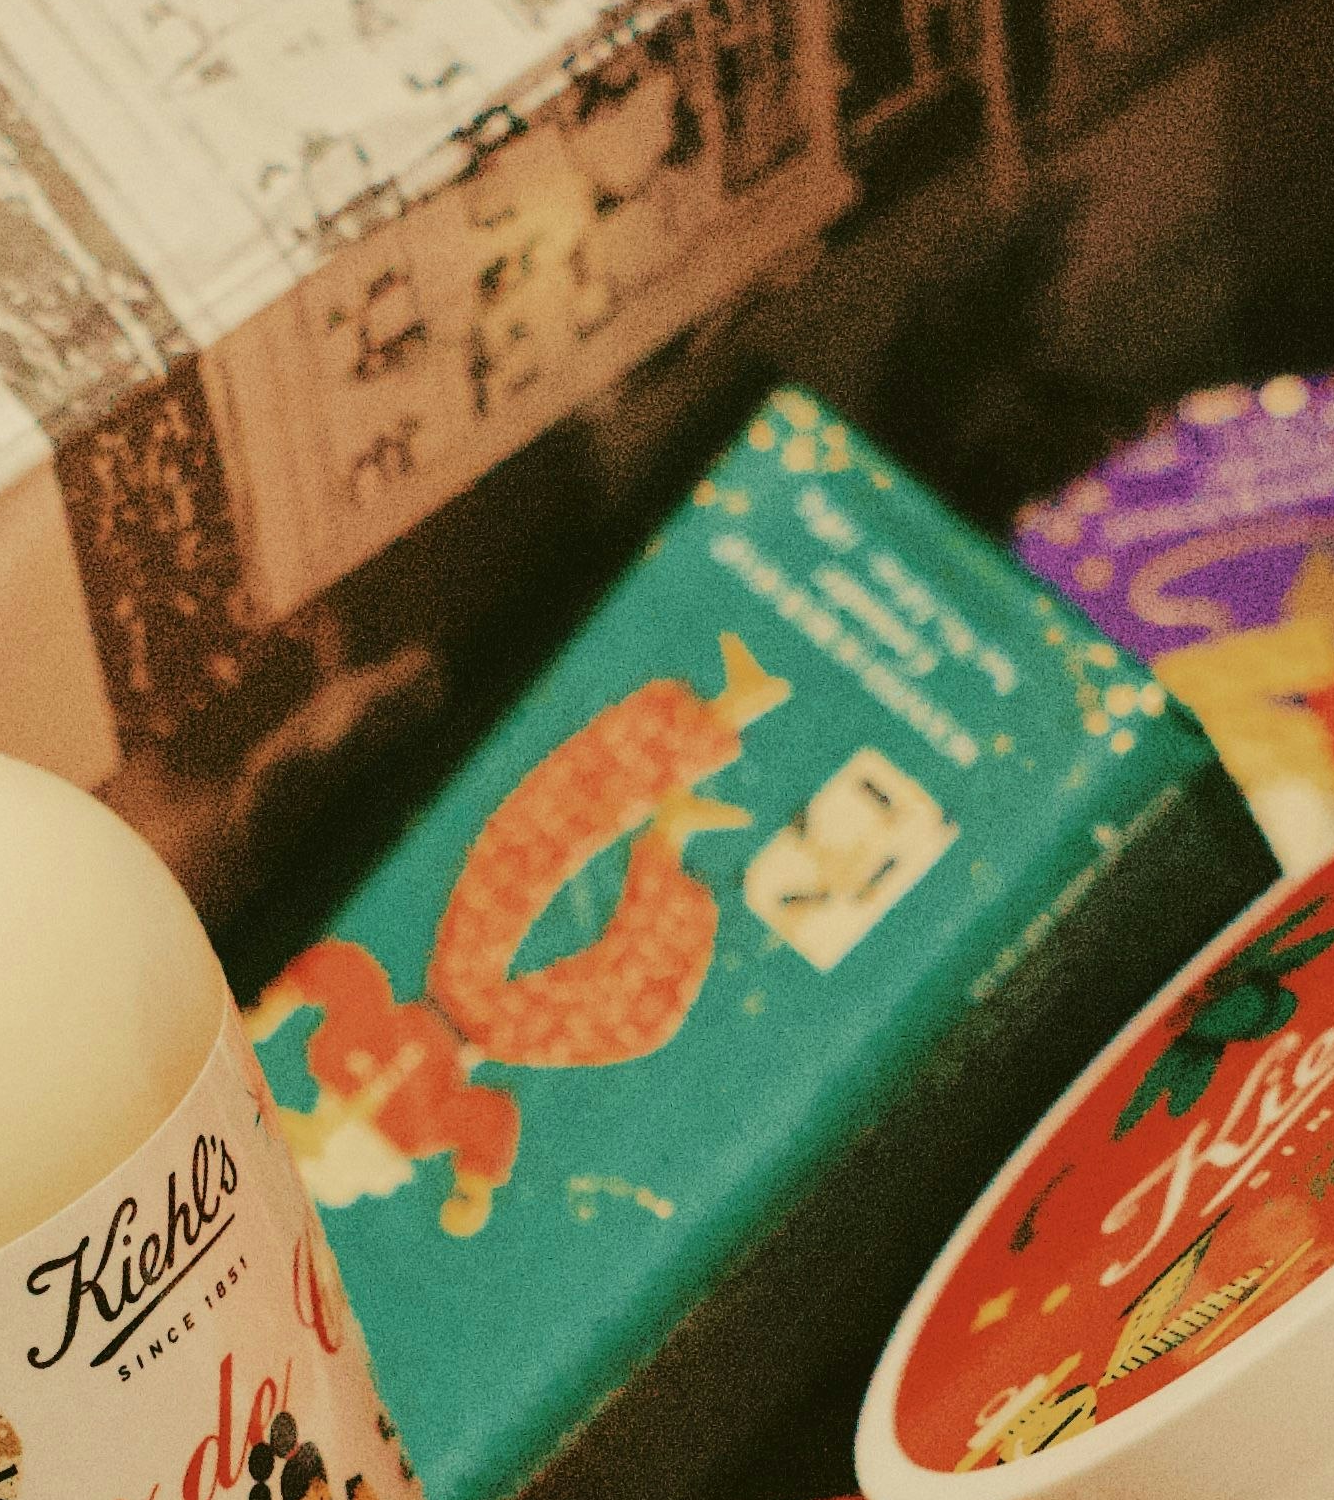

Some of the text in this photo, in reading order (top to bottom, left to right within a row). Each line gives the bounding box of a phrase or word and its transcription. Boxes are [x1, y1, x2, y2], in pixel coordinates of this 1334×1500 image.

[26, 1134, 239, 1370] Kiehl's
[117, 1311, 196, 1382] SINCE
[204, 1256, 251, 1311] 1851
